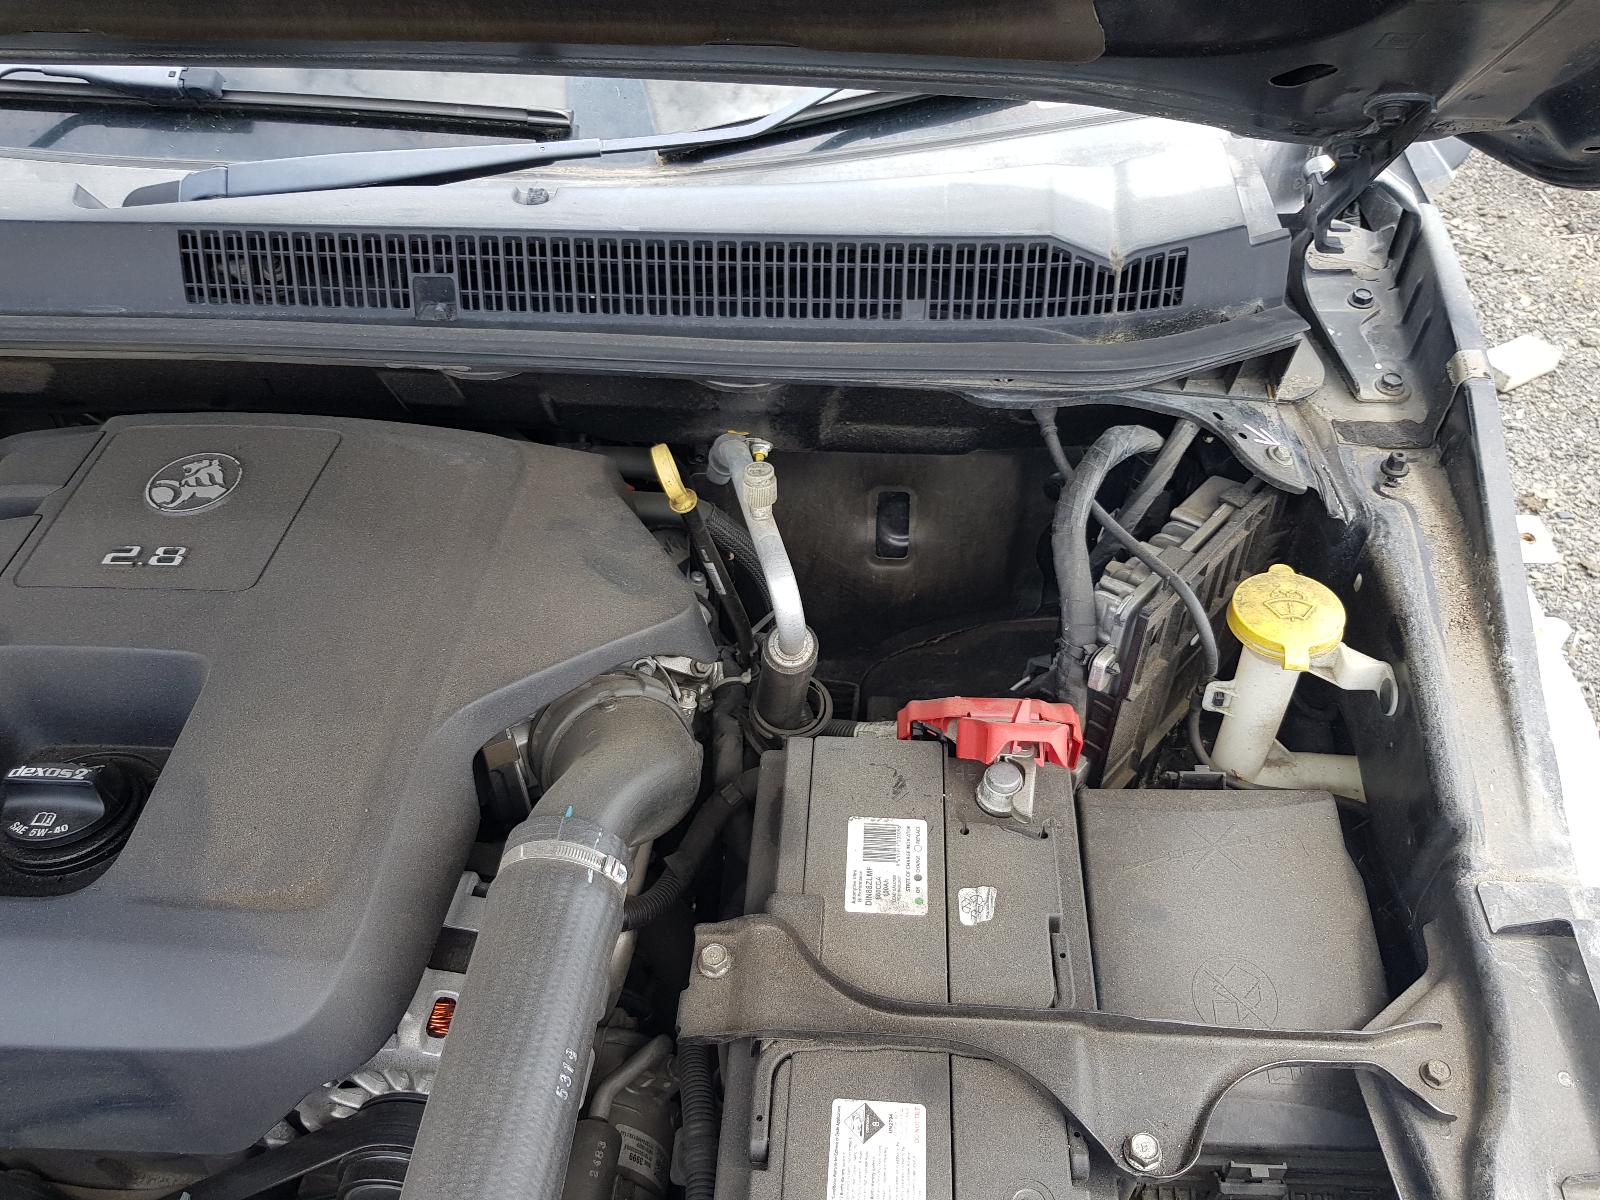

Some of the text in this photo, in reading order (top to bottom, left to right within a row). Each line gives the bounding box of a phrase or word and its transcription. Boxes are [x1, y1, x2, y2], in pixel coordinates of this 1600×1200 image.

[101, 545, 187, 567] 2.8
[9, 821, 69, 837] SAE 5W-40
